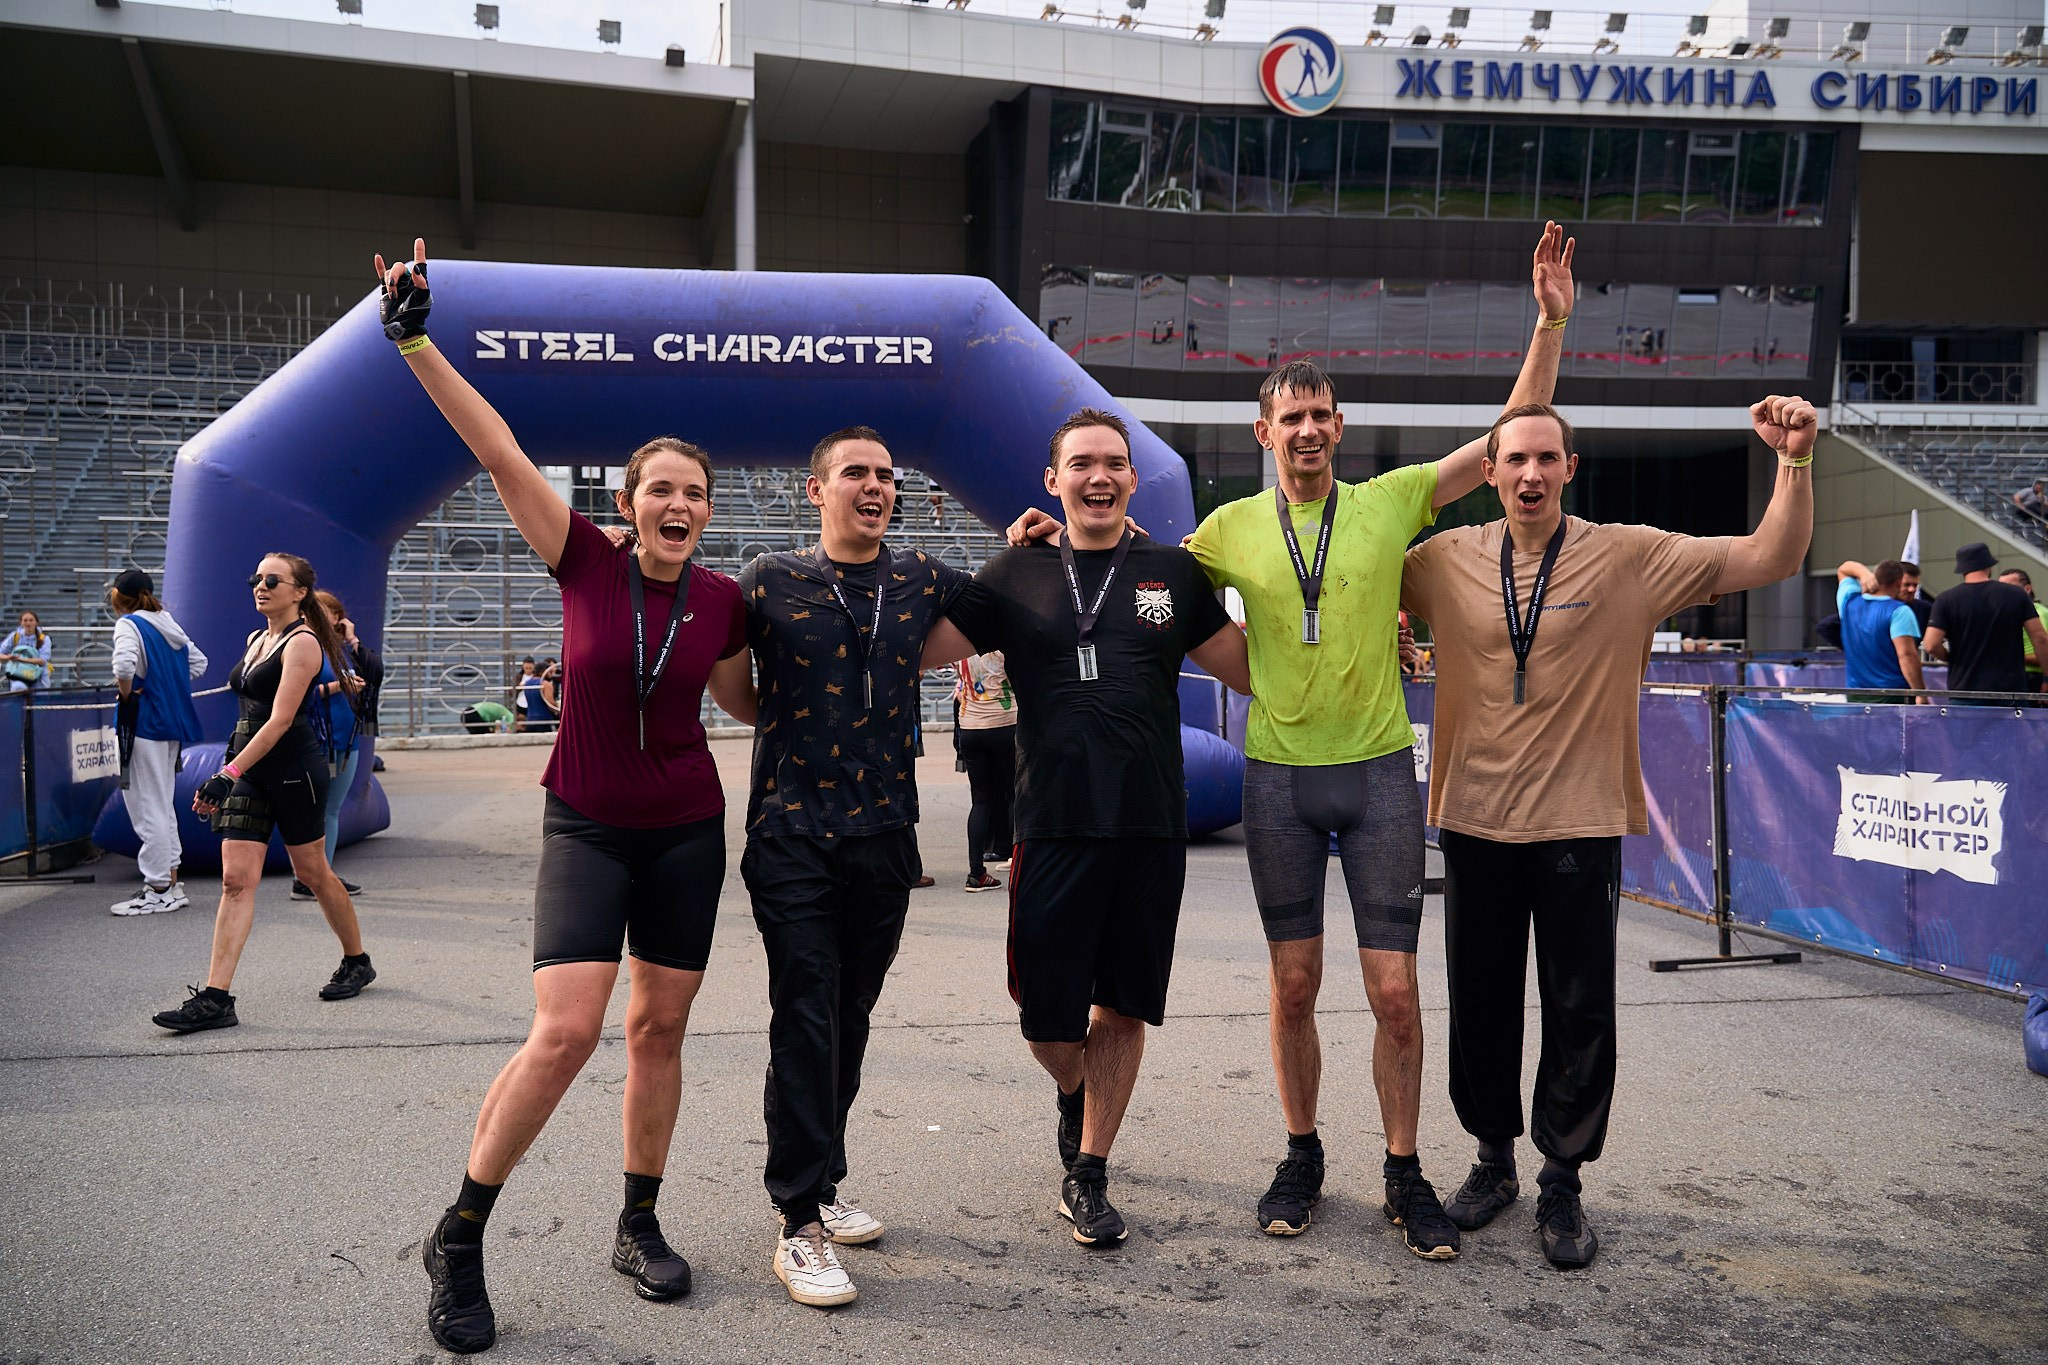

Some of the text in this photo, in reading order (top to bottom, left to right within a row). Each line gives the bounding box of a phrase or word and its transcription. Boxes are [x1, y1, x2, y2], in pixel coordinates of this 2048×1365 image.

[1396, 58, 2039, 115] ЖЕМЧУЖИНА СИБИРИ
[475, 330, 933, 364] STEEL CHARACTER
[1508, 606, 1518, 635] СТАЛЬНОЙ
[1527, 576, 1545, 634] СТАЛЬНОЙ ХАРАКТЕР
[653, 648, 668, 676] СТАЛЬНОЙ
[76, 740, 115, 755] СТАЛЬН
[77, 754, 115, 769] ХАРАКТ
[1851, 793, 1989, 828] СТАЛЬНОЙ
[1851, 818, 1989, 855] ХАРАКТЕР
